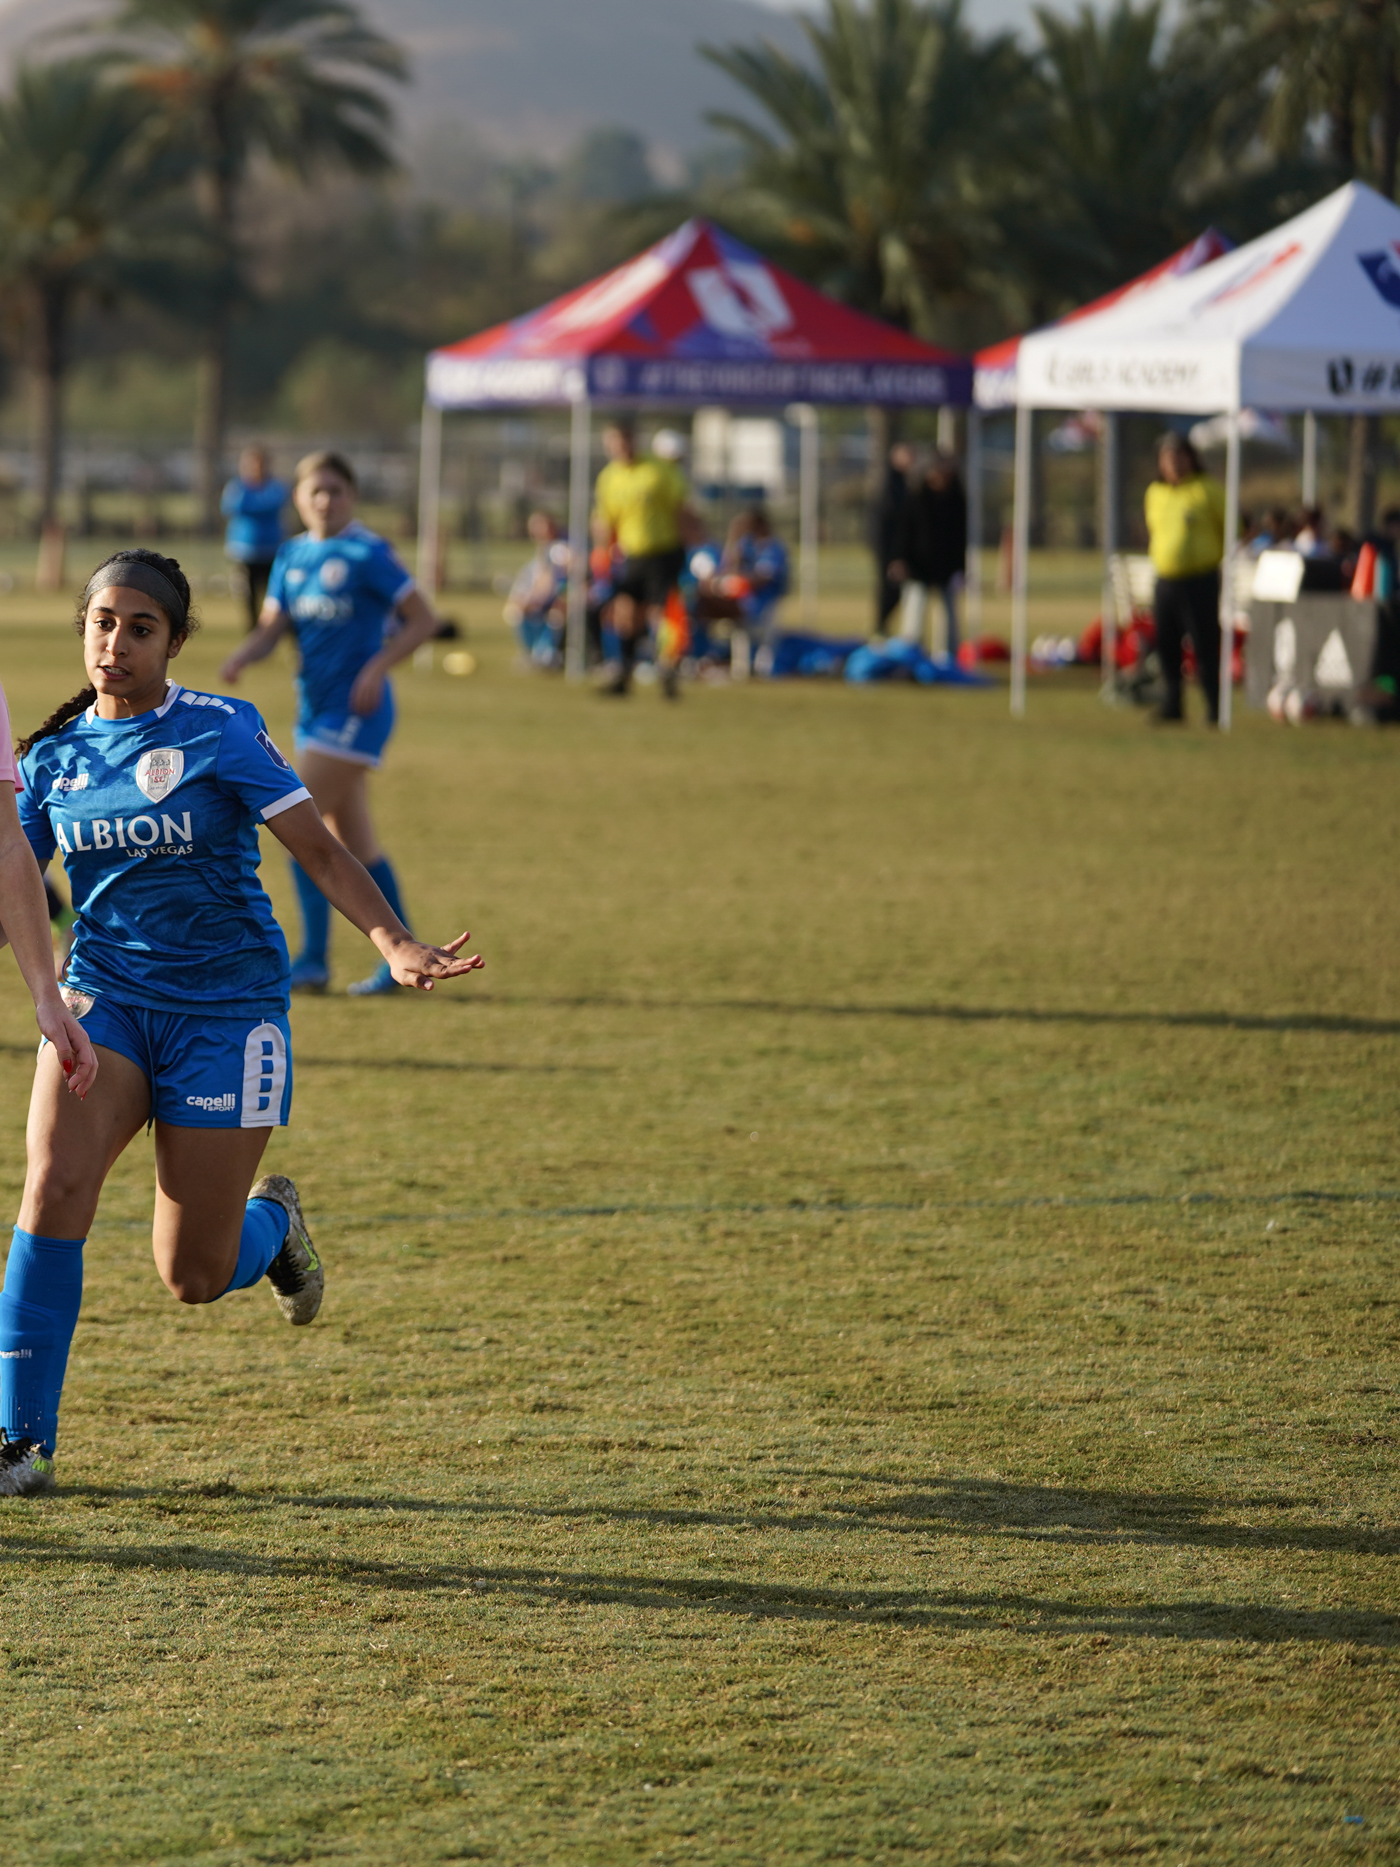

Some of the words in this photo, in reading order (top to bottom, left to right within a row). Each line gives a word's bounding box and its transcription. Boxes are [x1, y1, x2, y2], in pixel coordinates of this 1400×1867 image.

[145, 768, 176, 776] ALBION
[56, 811, 193, 853] ALBION
[126, 848, 148, 859] LAS
[150, 844, 194, 856] VEGAS
[186, 1093, 236, 1110] capelli
